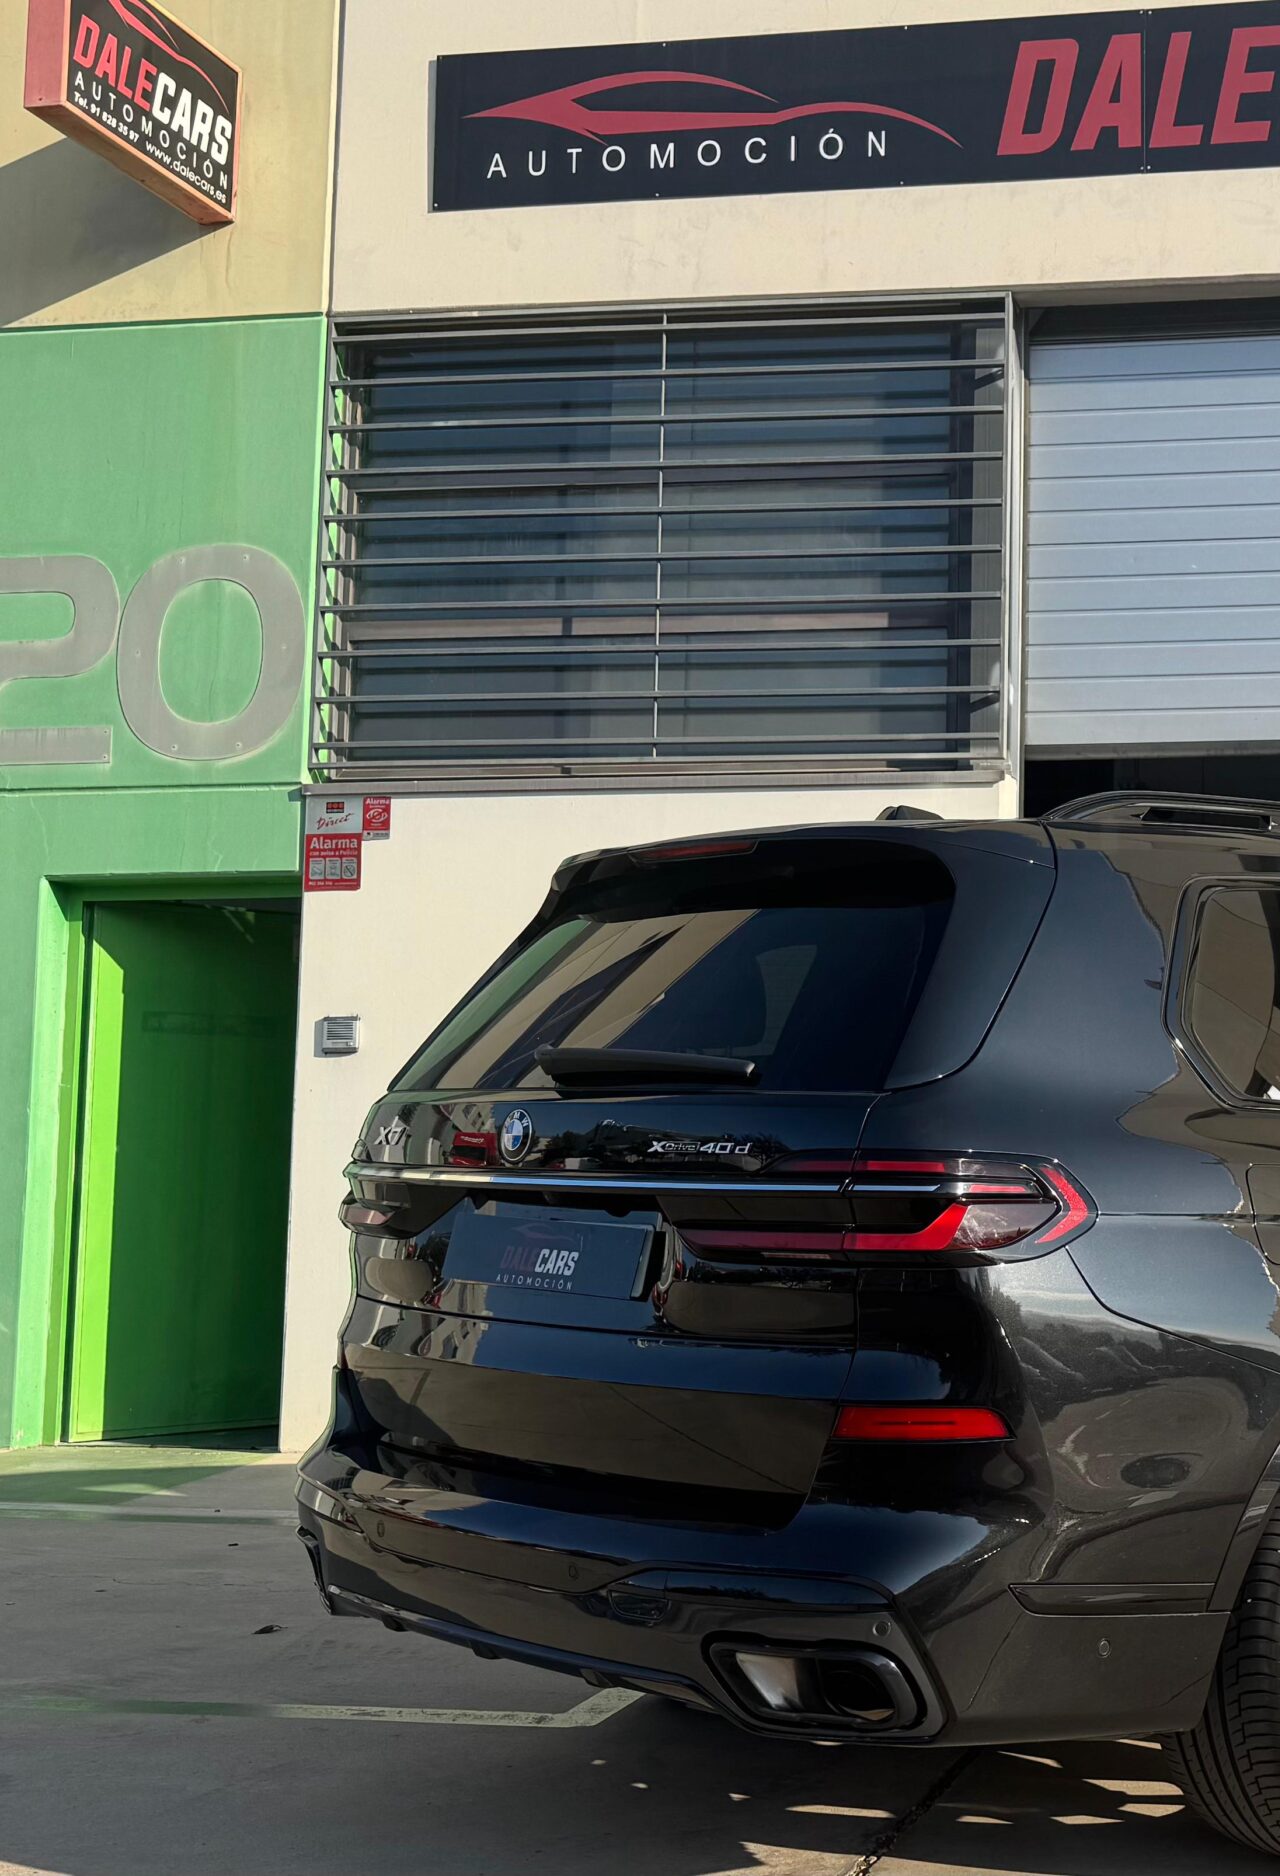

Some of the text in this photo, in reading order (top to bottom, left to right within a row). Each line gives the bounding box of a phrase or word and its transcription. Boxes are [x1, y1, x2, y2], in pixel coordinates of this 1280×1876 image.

[73, 14, 232, 166] DALECARS
[75, 71, 228, 190] AUTOMOCIÓN
[73, 91, 226, 204] Tel. 91 828 35 97 www.dalecars.es
[486, 128, 887, 179] AUTOMOCIÓN
[365, 797, 390, 805] Alarma
[310, 836, 358, 849] Alarma
